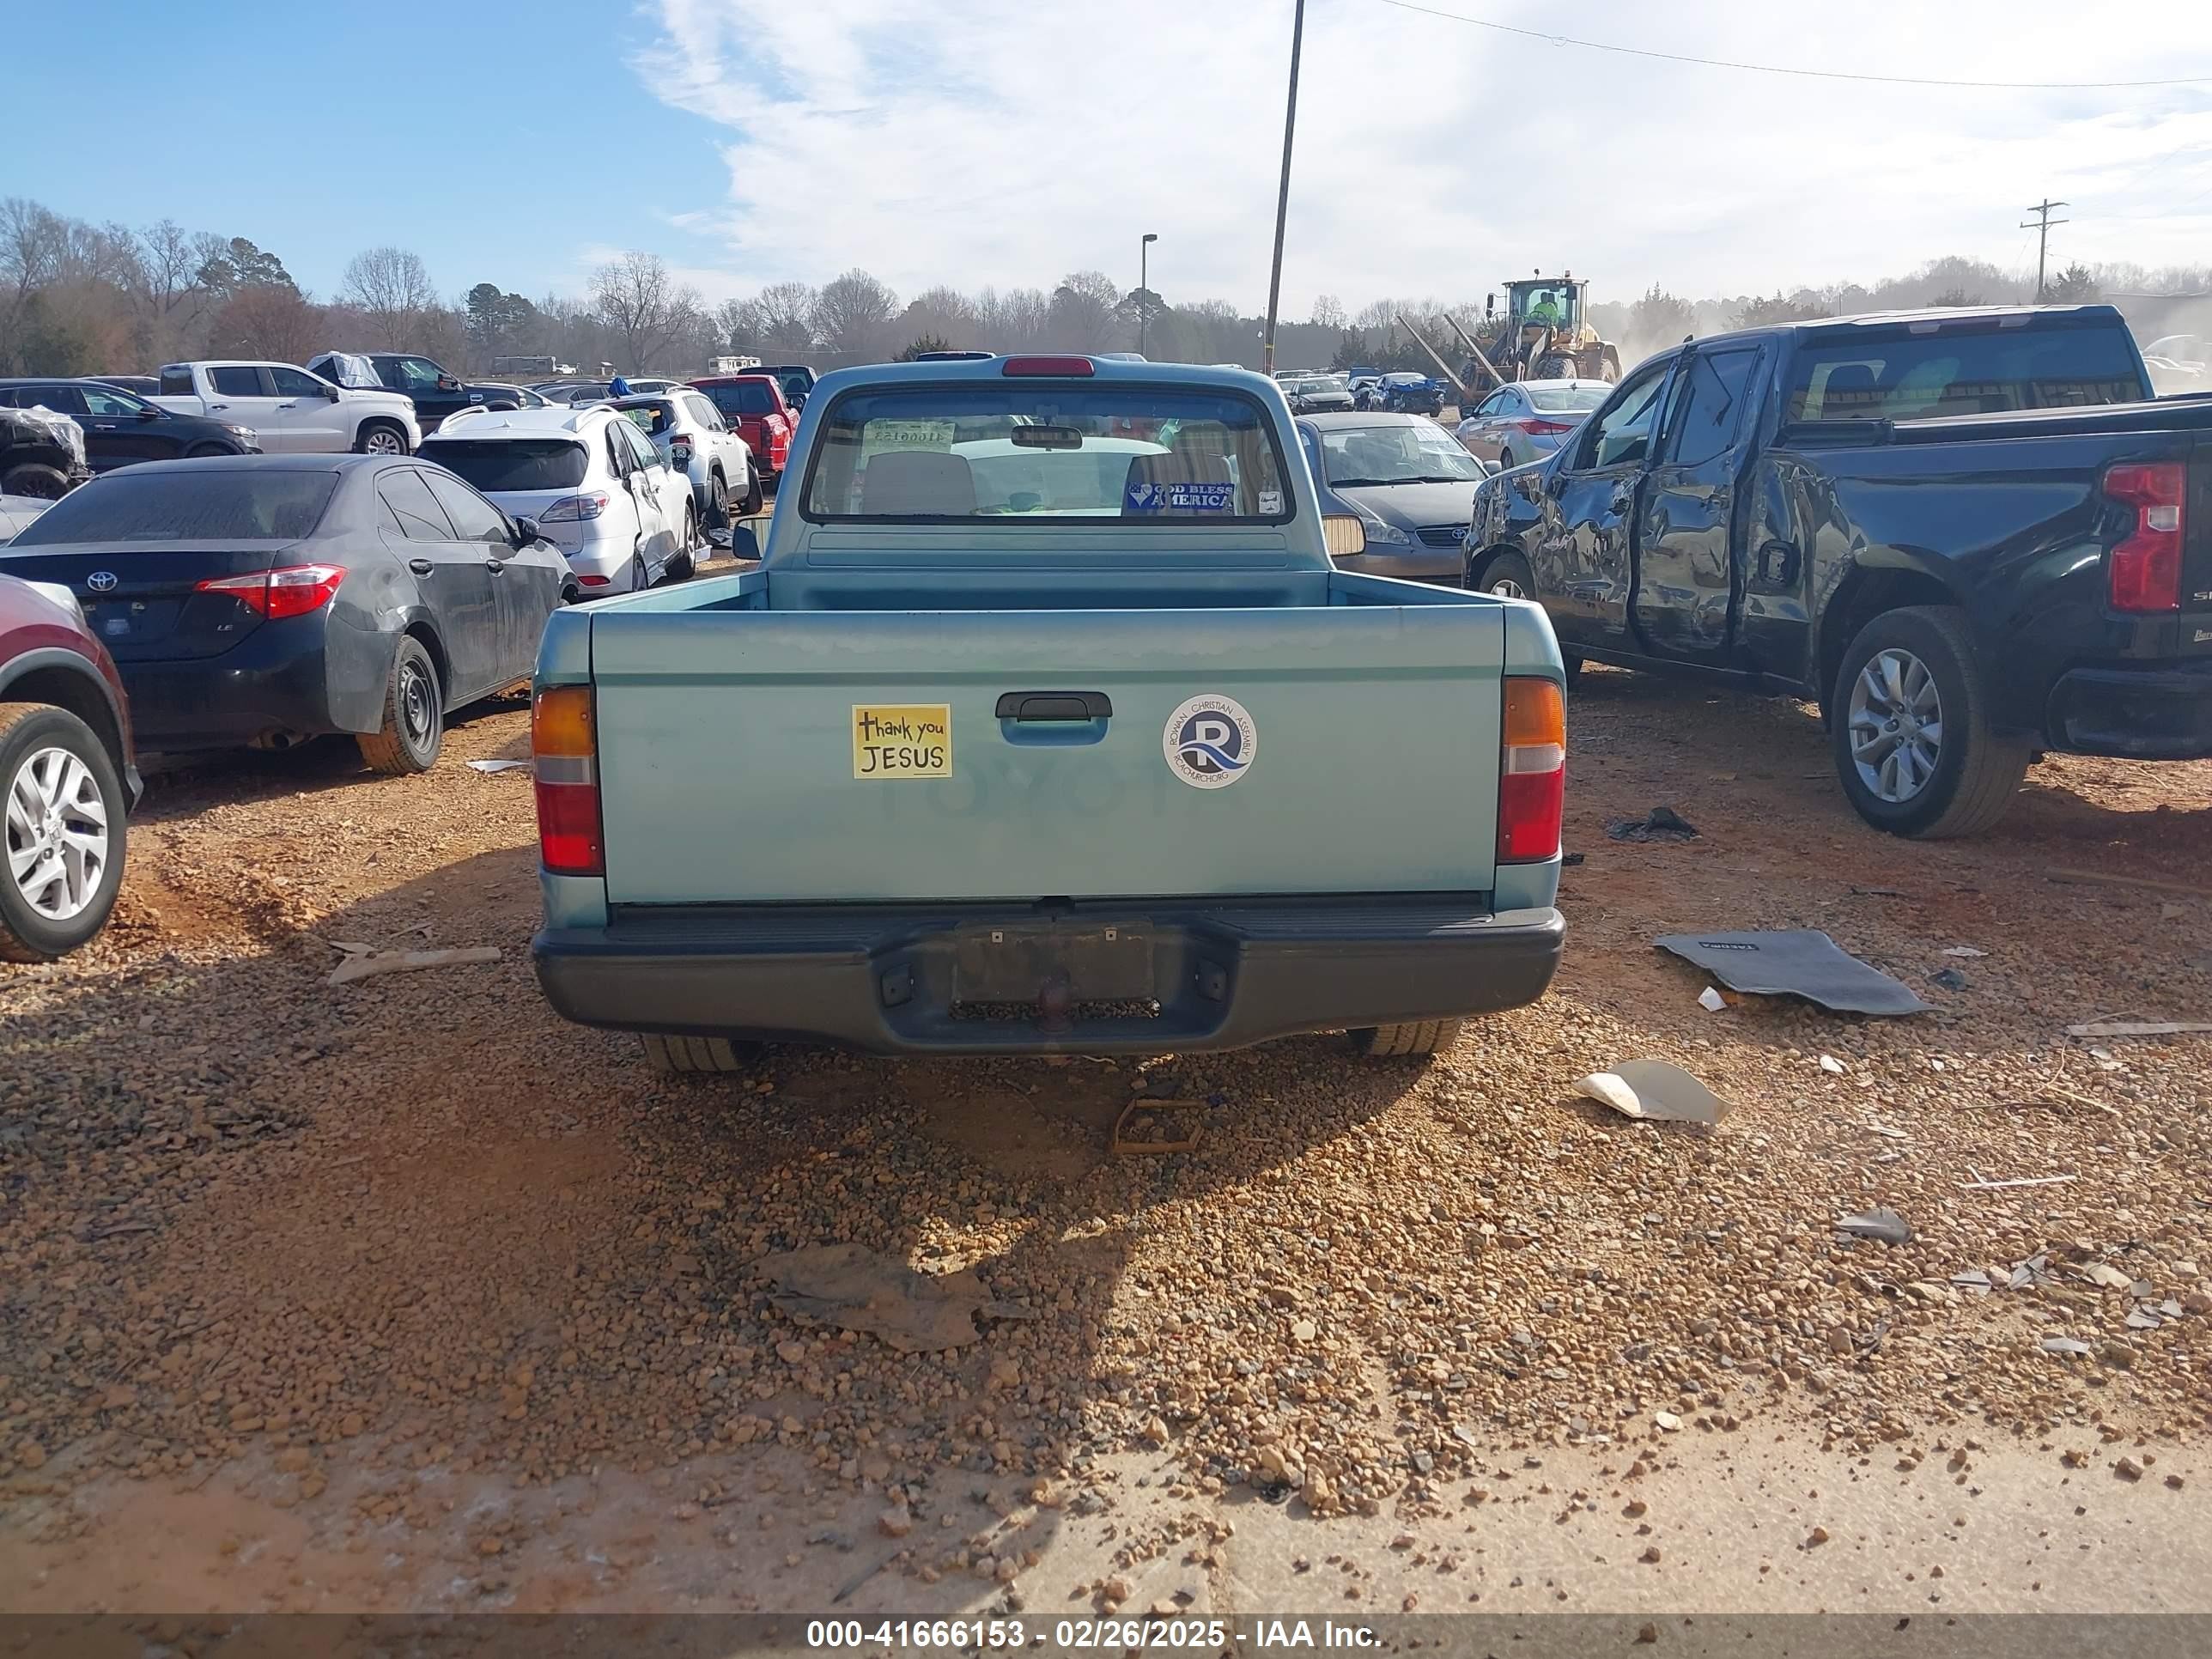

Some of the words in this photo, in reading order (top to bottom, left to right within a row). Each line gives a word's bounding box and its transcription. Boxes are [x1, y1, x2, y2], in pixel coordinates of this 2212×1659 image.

[1189, 484, 1233, 495] BLESS
[917, 723, 944, 744] you
[1169, 713, 1188, 746] ROWAN
[1191, 701, 1234, 715] CHRISTIAN
[1236, 716, 1251, 757] ASSEMBLY
[861, 745, 944, 773] JESUS
